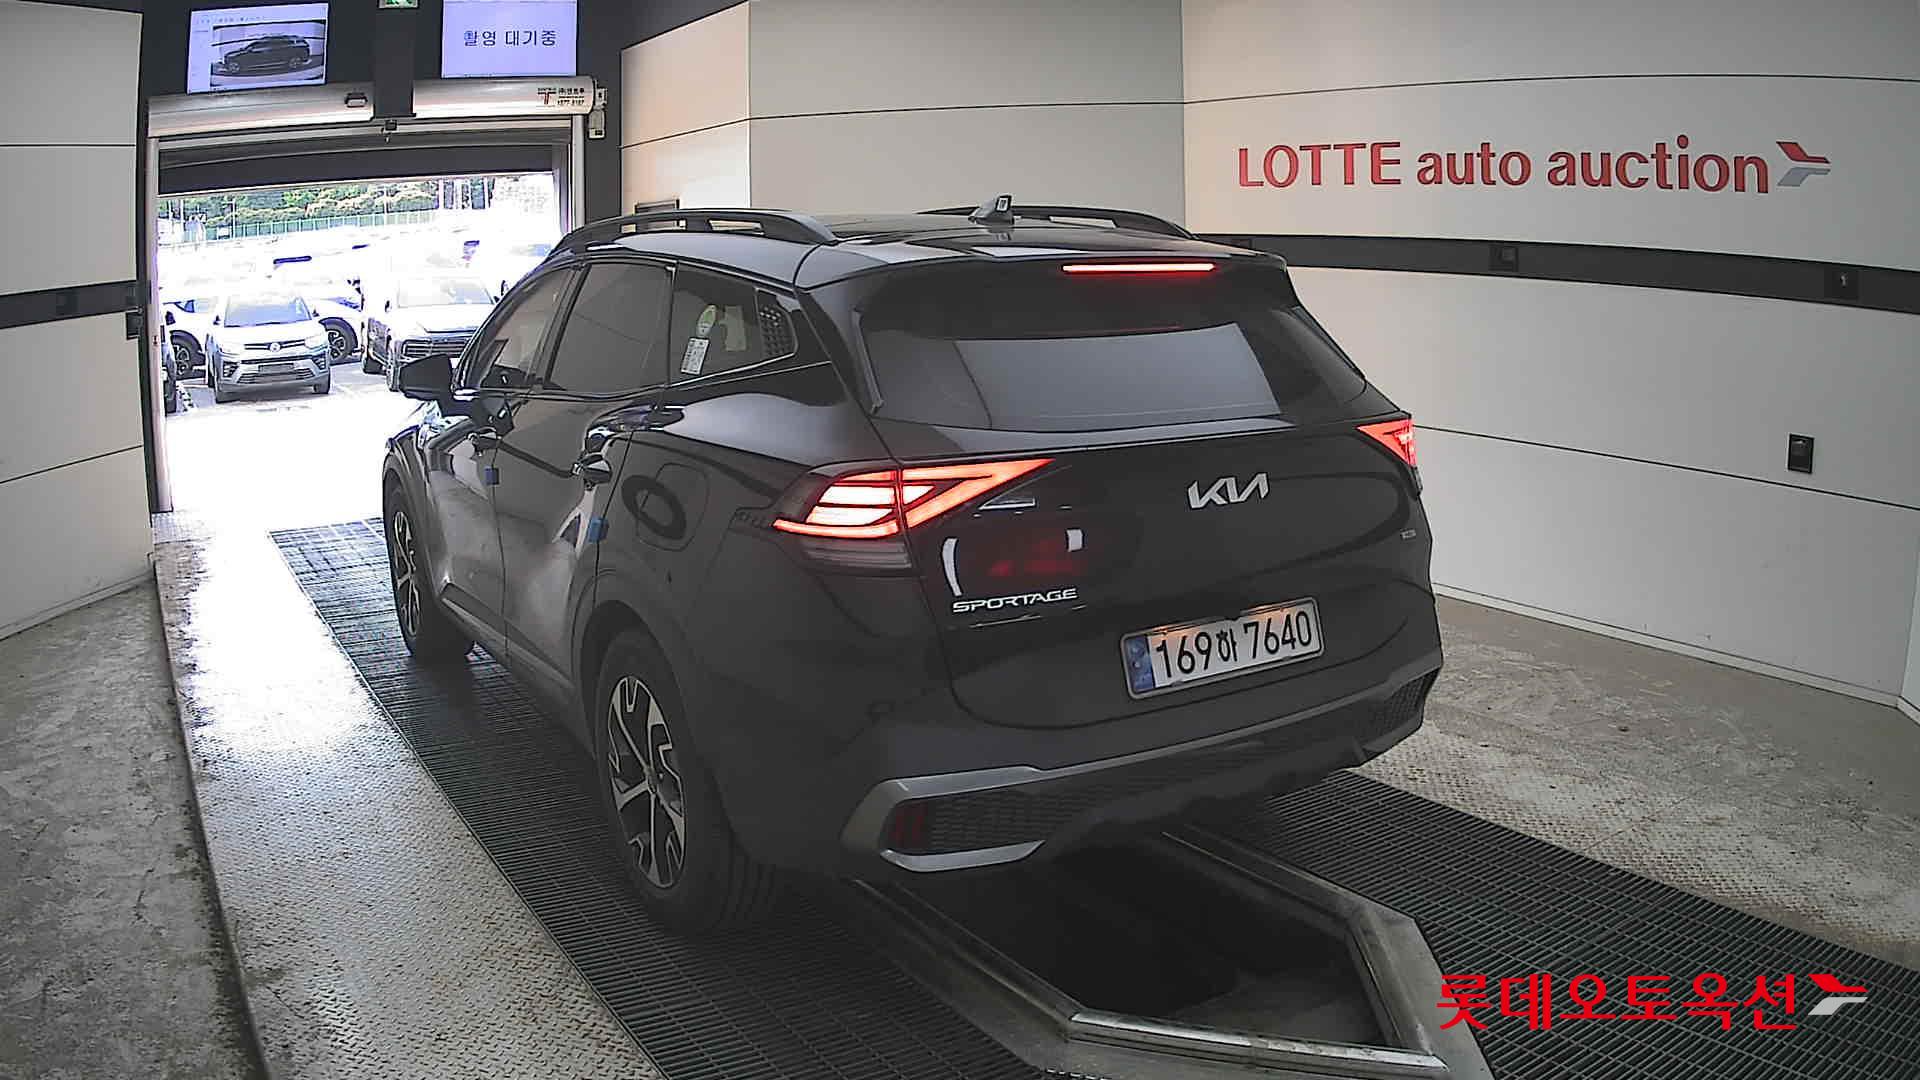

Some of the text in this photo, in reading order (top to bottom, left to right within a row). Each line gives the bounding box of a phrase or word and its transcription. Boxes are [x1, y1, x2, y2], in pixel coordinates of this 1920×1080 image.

[505, 30, 557, 47] 대기중
[1239, 135, 1768, 193] LOTTE auto auction
[1188, 473, 1269, 510] KIA
[952, 588, 1078, 613] SPORTAGE
